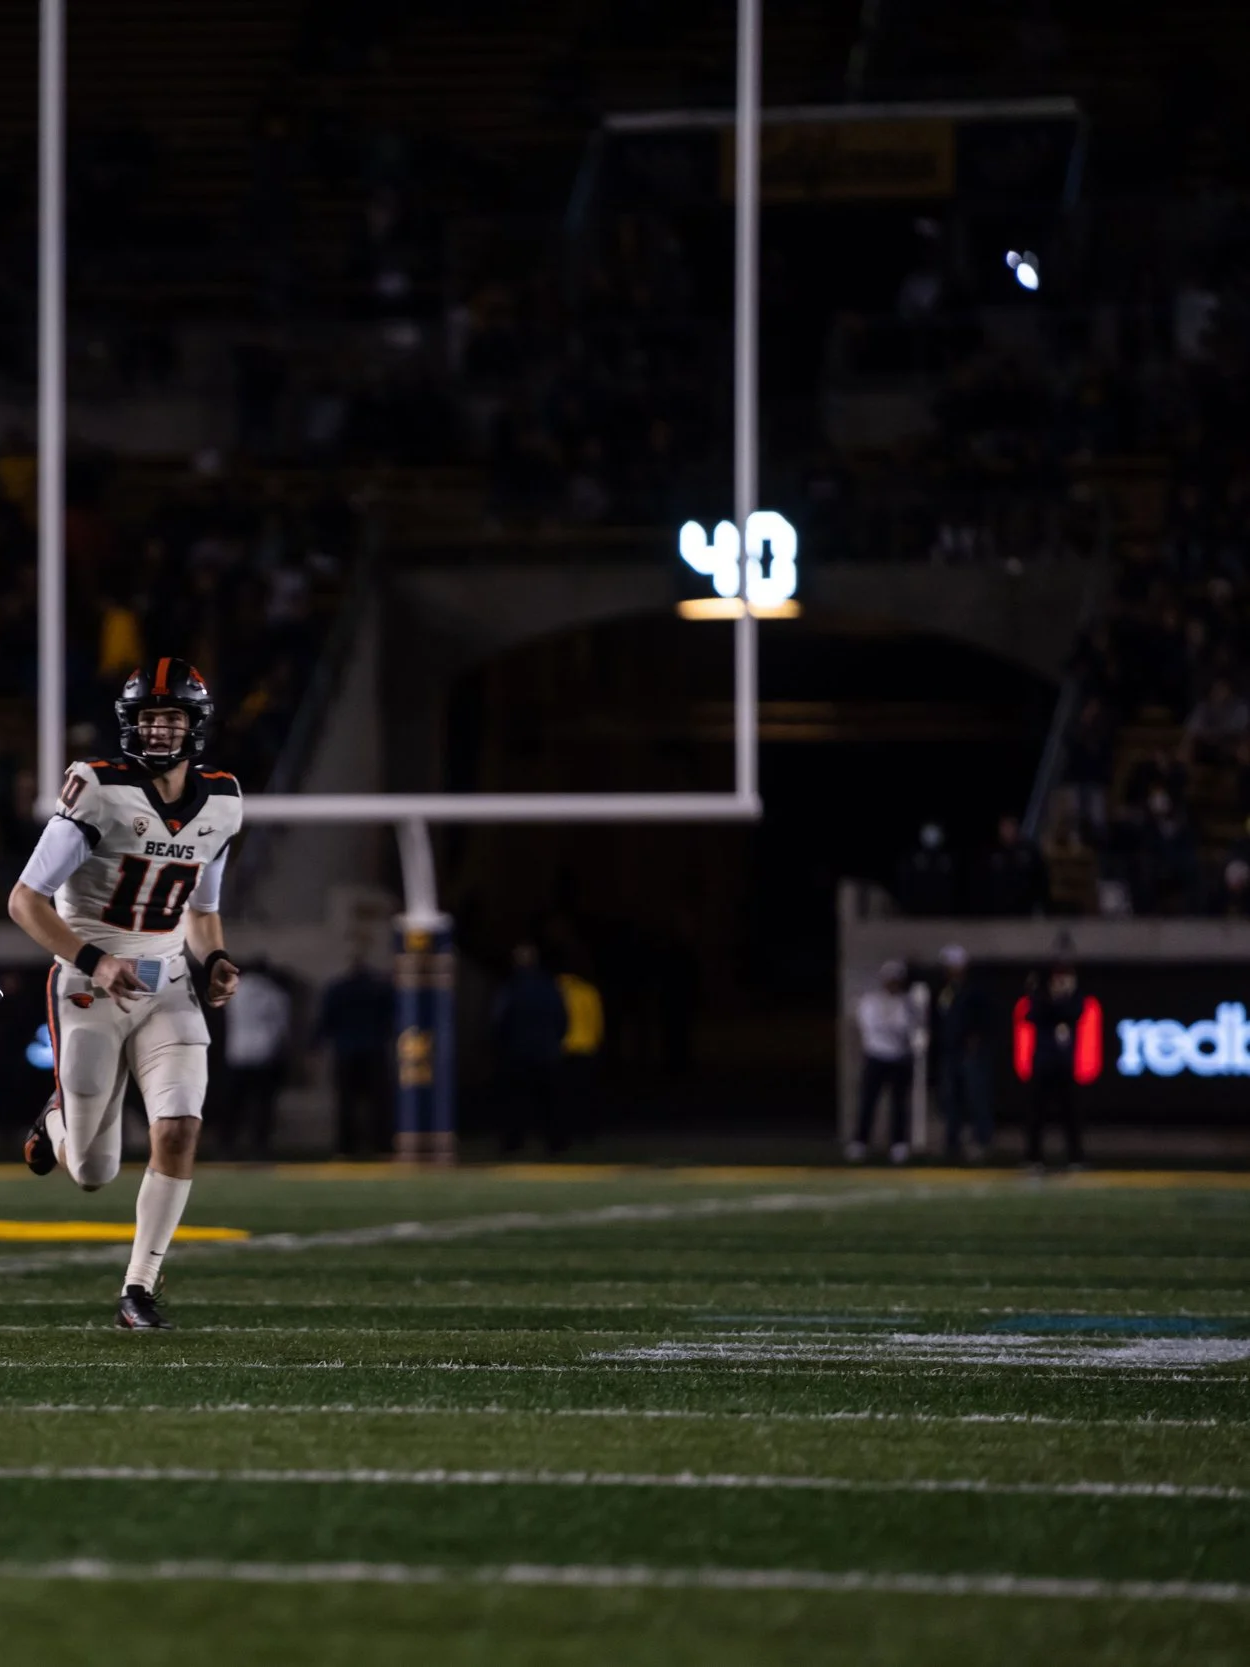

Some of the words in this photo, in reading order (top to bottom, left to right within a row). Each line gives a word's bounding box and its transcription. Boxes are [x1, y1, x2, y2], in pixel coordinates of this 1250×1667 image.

[679, 511, 798, 607] 40
[145, 841, 194, 860] BEAVS
[102, 854, 200, 933] 10
